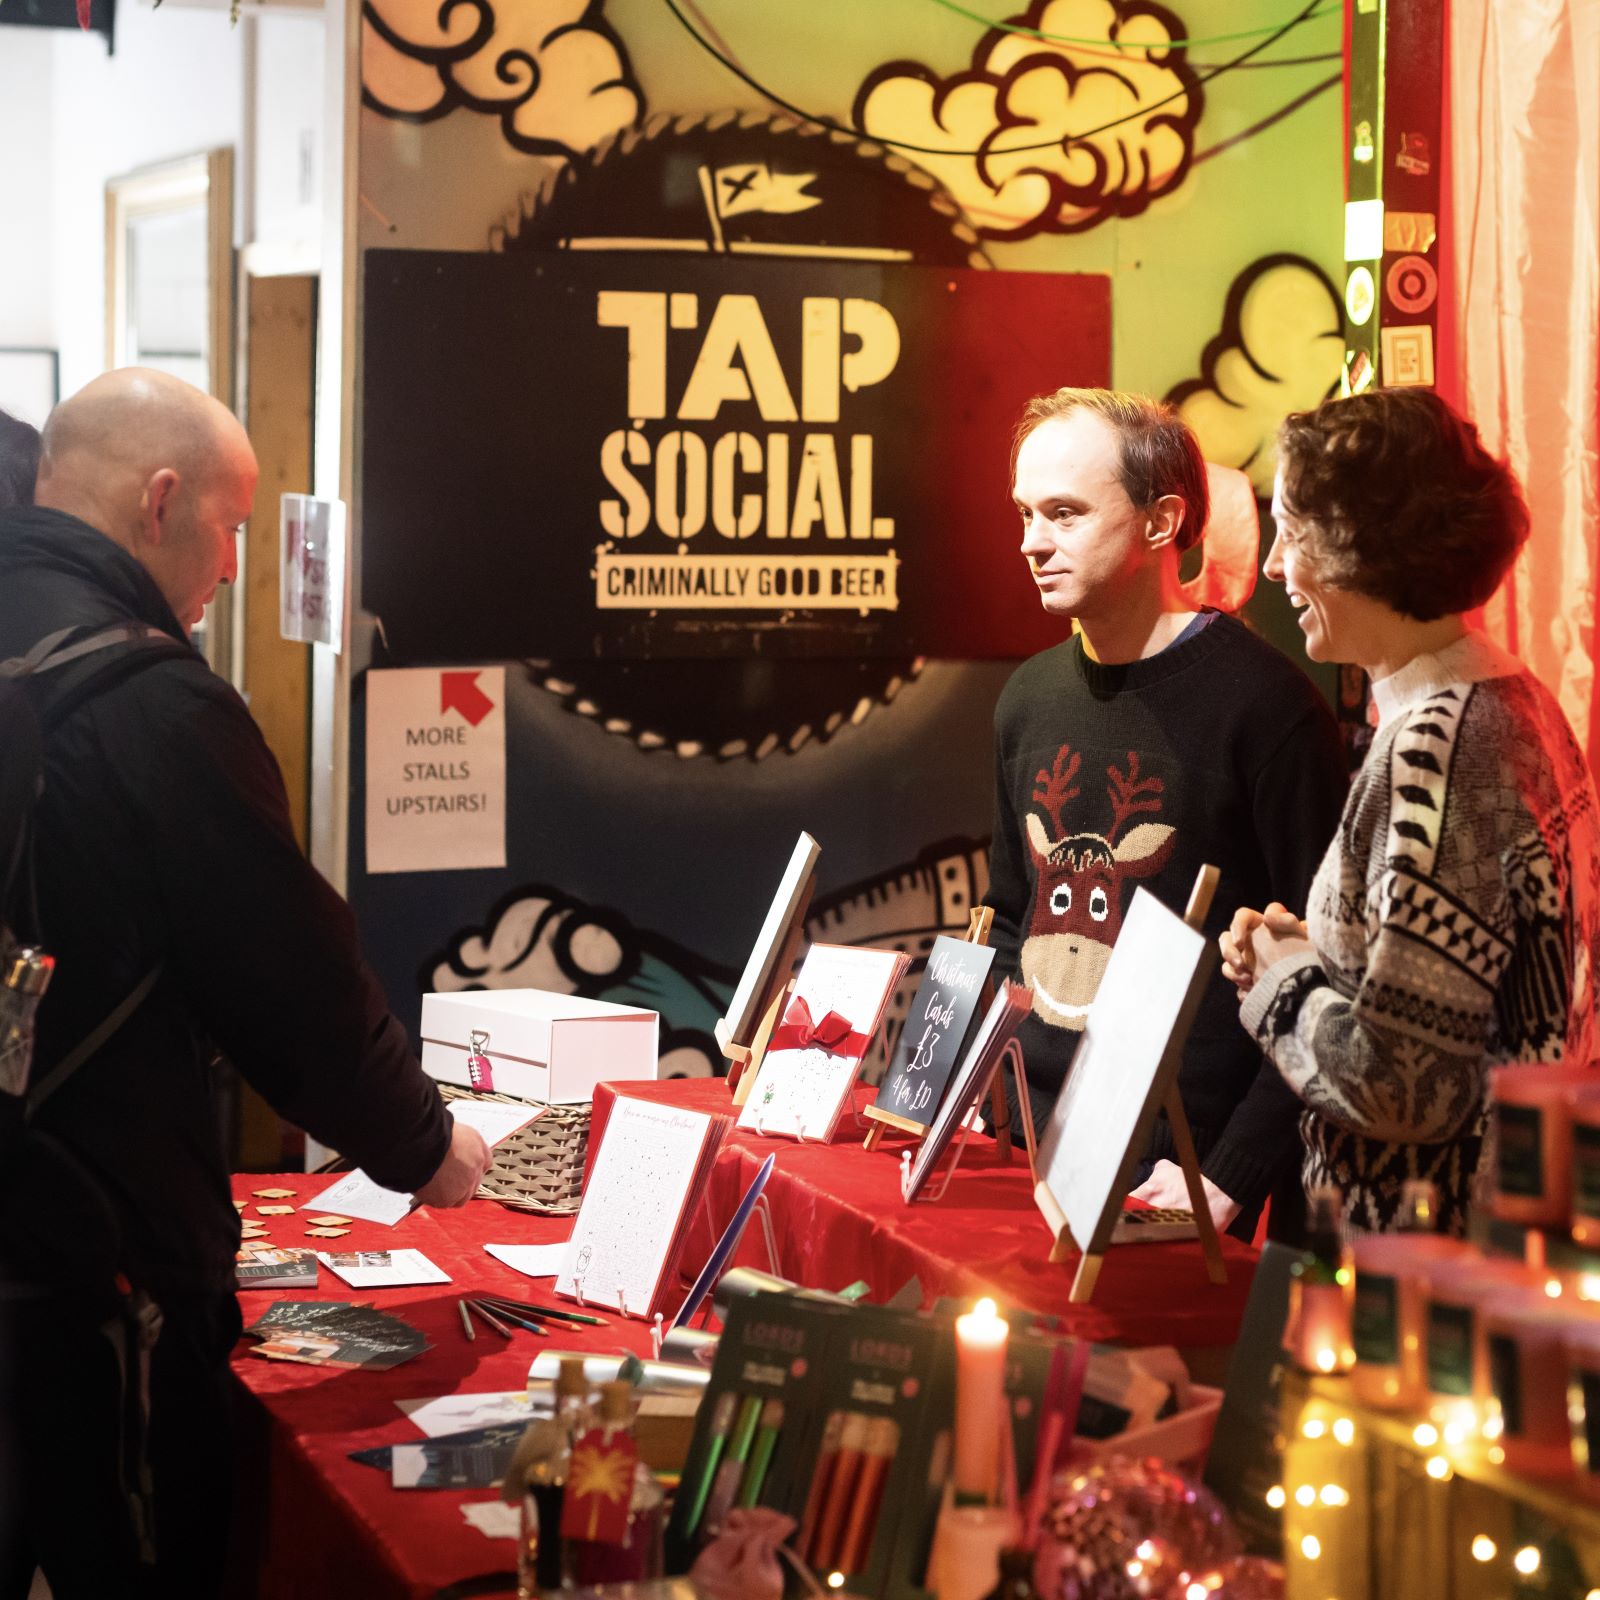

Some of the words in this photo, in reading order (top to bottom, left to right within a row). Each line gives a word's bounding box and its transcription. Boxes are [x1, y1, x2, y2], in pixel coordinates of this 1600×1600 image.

[597, 290, 900, 422] TAP
[600, 429, 895, 539] SOCIAL
[607, 566, 750, 597] CRIMINALLY
[758, 567, 820, 597] GOOD
[831, 567, 886, 597] BEER
[405, 726, 467, 746] MORE
[402, 760, 470, 782] STALLS
[386, 793, 487, 816] UPSTAIRS!
[931, 951, 978, 992] Christmas
[924, 991, 957, 1029] Cards
[906, 1024, 941, 1072] £3
[892, 1073, 903, 1096] 4
[896, 1078, 912, 1106] for
